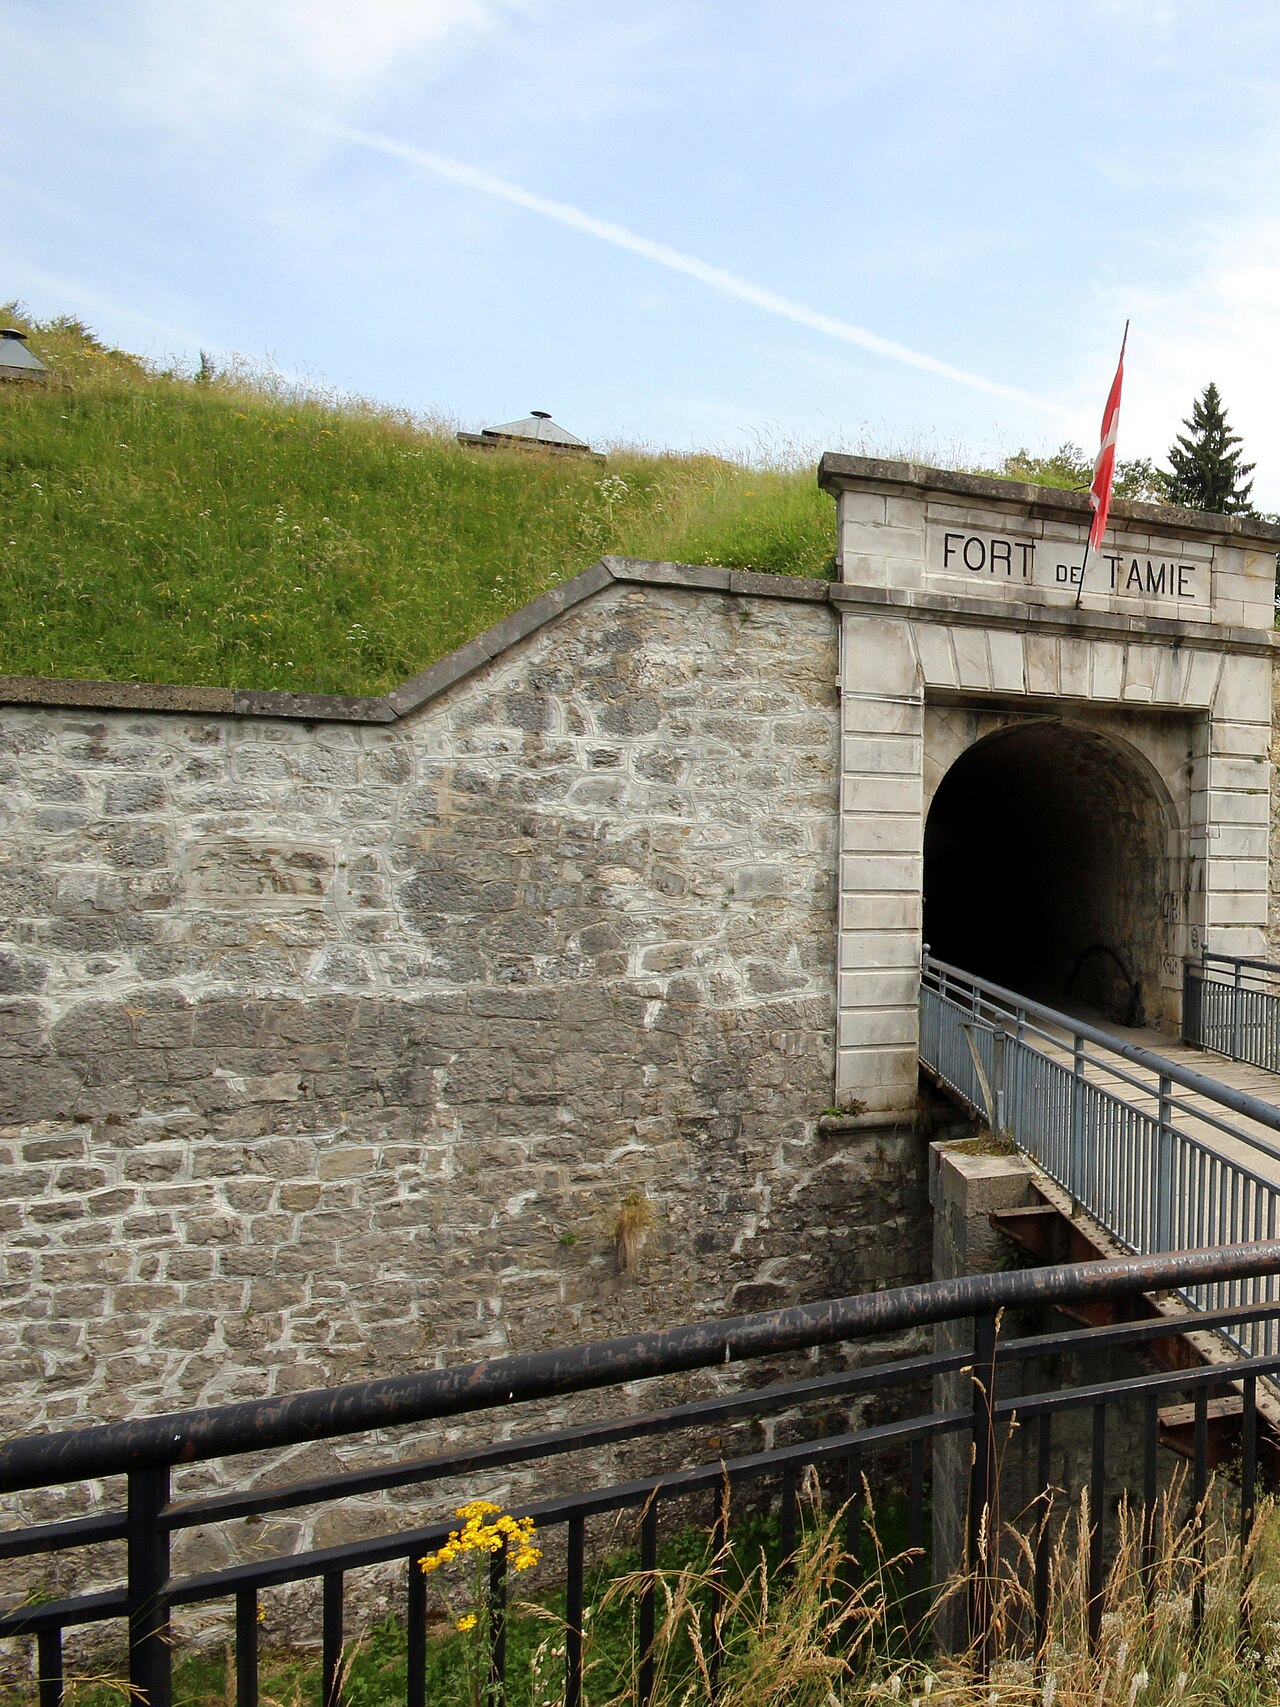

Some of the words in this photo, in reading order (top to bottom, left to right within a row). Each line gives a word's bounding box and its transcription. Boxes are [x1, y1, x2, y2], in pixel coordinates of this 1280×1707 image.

[944, 533, 1036, 577] FORT
[1056, 564, 1082, 584] DE
[1103, 554, 1195, 598] TAMIE
